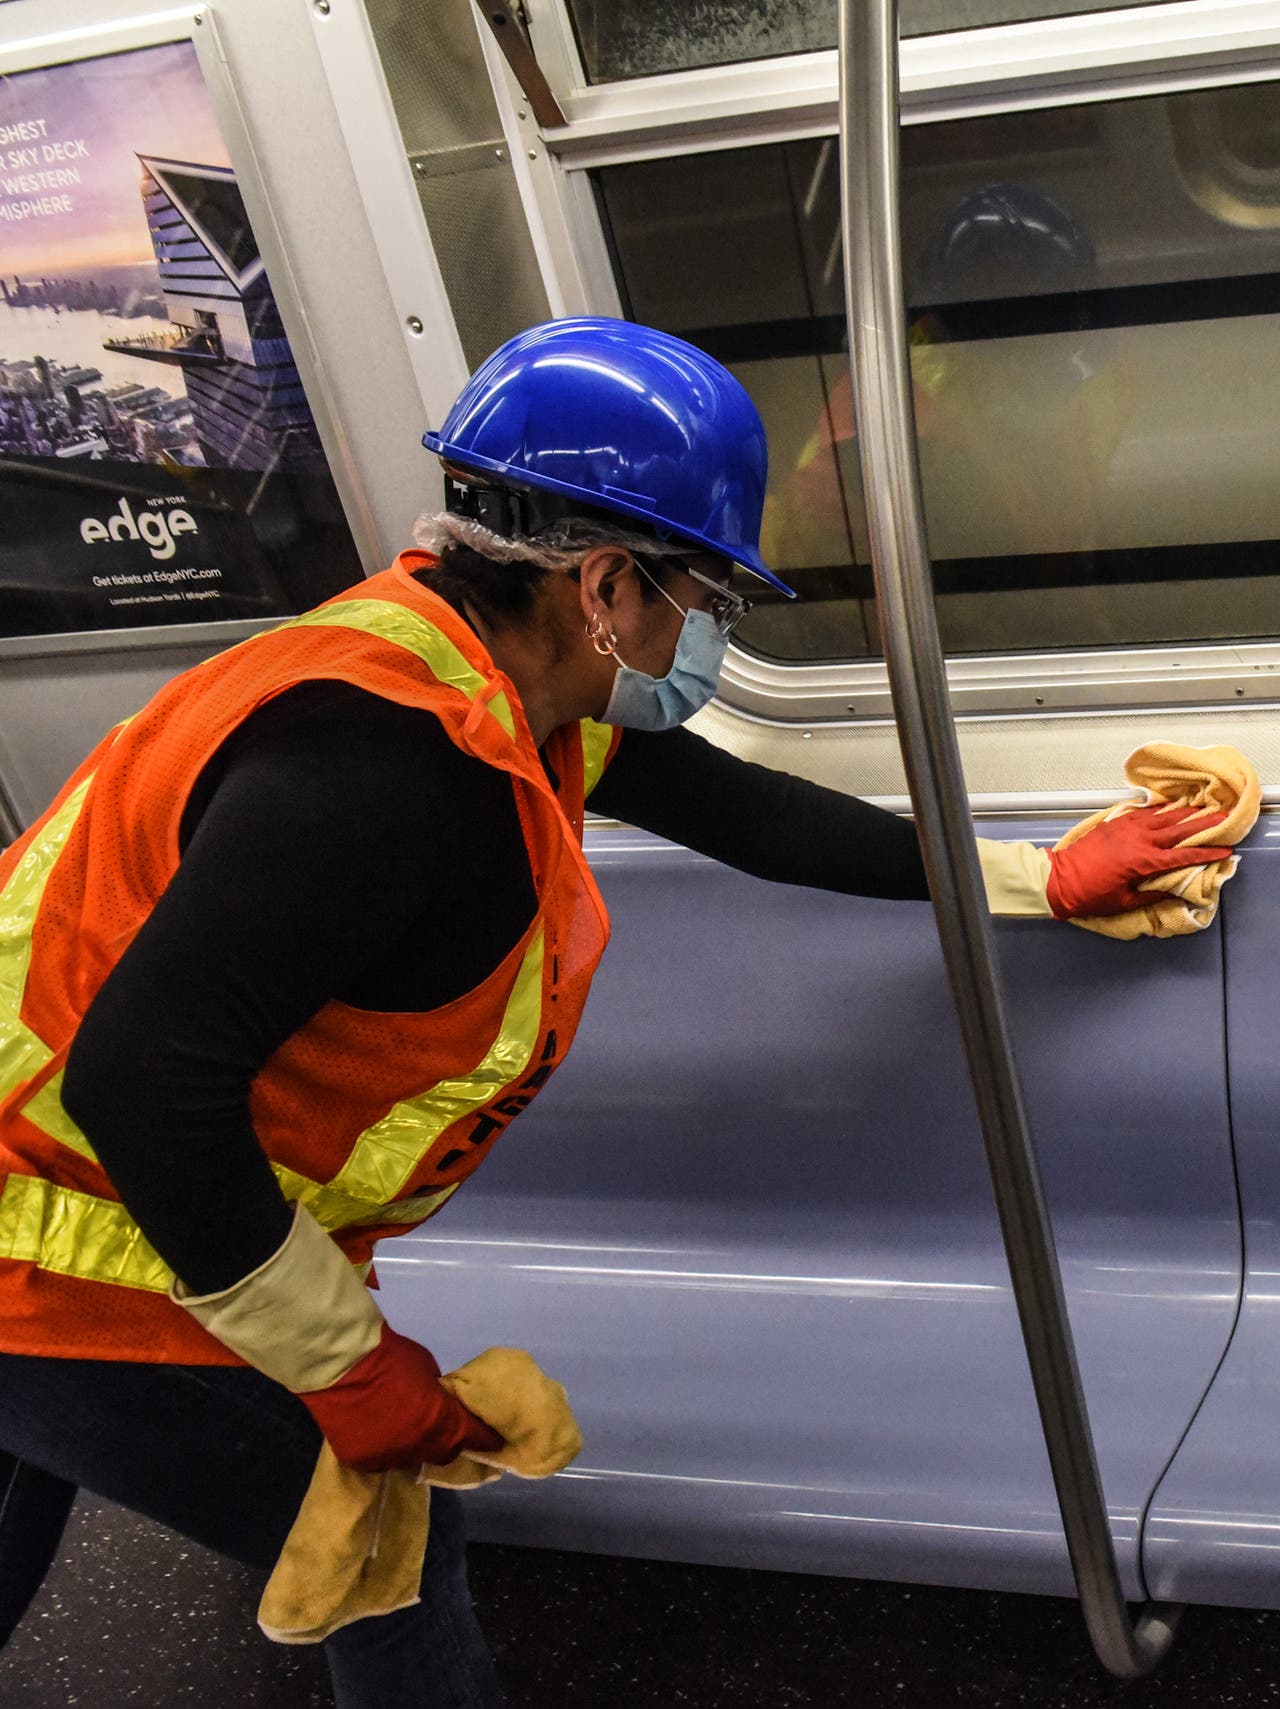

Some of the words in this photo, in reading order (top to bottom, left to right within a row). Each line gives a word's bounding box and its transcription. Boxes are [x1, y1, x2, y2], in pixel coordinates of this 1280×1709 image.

[8, 146, 39, 169] SKY
[41, 139, 90, 163] DECK
[2, 167, 82, 195] WESTERN
[146, 498, 164, 506] NEW
[165, 496, 186, 505] YORK
[80, 496, 199, 560] edge
[92, 575, 112, 587] Get
[112, 574, 143, 586] tickets
[143, 573, 154, 583] at
[153, 568, 222, 583] EdgeNYC.com
